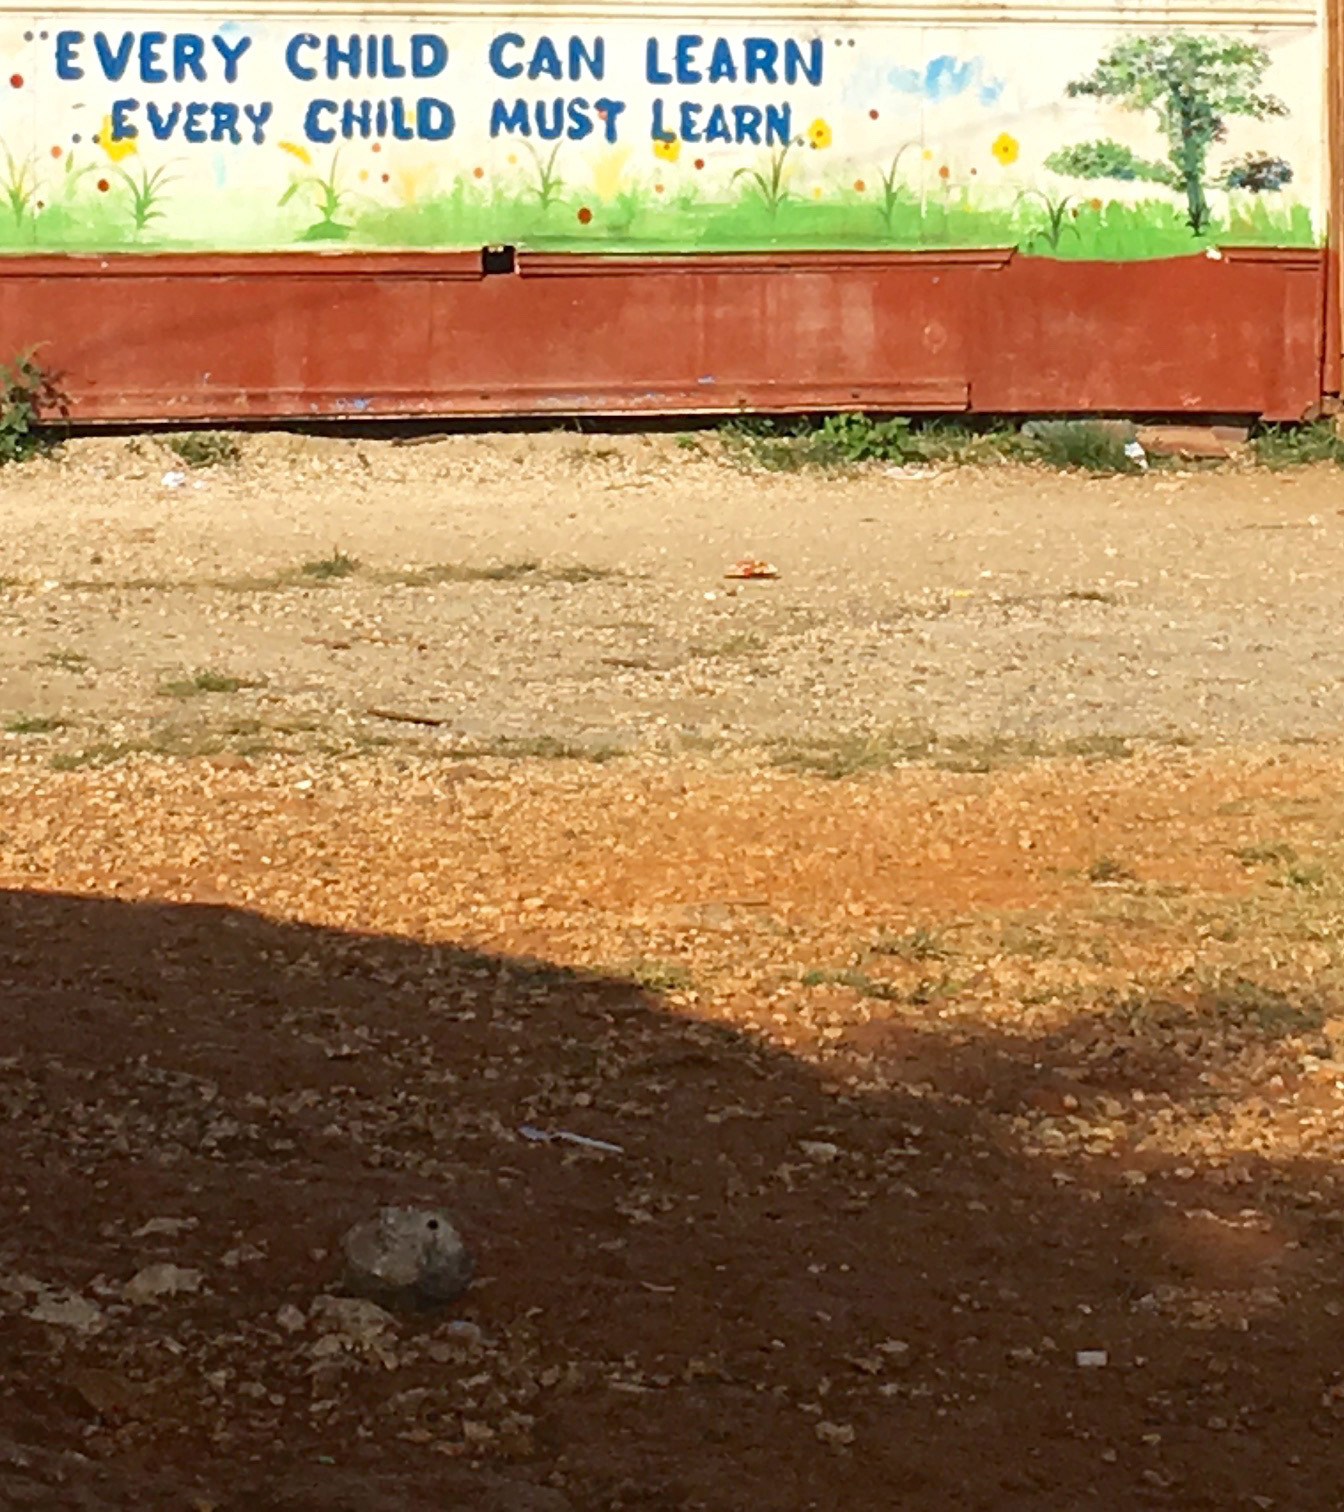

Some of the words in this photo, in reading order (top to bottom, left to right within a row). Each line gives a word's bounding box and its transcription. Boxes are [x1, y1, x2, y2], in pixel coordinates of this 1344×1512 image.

[284, 32, 449, 82] CHILD
[488, 32, 606, 82] CAN
[303, 96, 456, 143] CHILD
[488, 97, 627, 146] MUST
